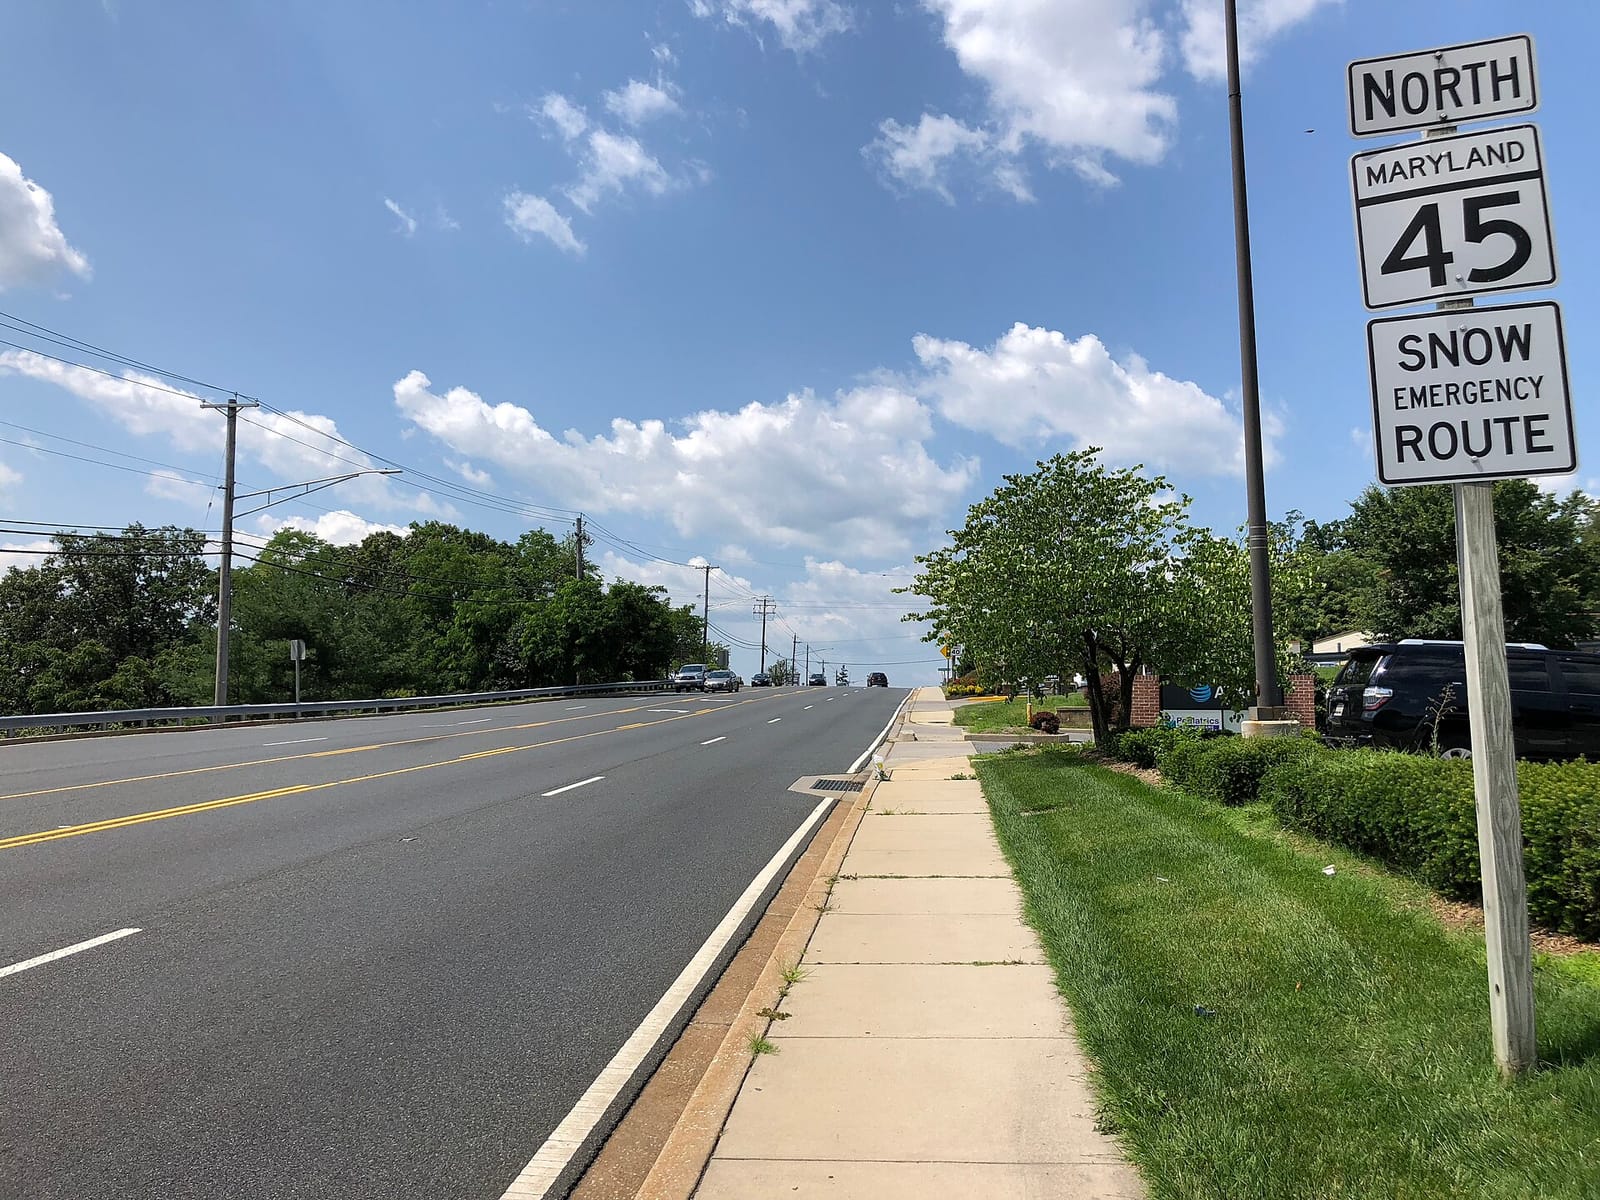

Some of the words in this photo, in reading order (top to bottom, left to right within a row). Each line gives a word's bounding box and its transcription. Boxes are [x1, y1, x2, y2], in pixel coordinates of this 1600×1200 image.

[1363, 56, 1520, 121] NORTH
[1367, 141, 1525, 186] MARYLAND
[1380, 190, 1532, 288] 45
[1398, 324, 1532, 372] SNOW
[1394, 376, 1543, 410] EMERGENCY
[1395, 414, 1554, 463] ROUTE
